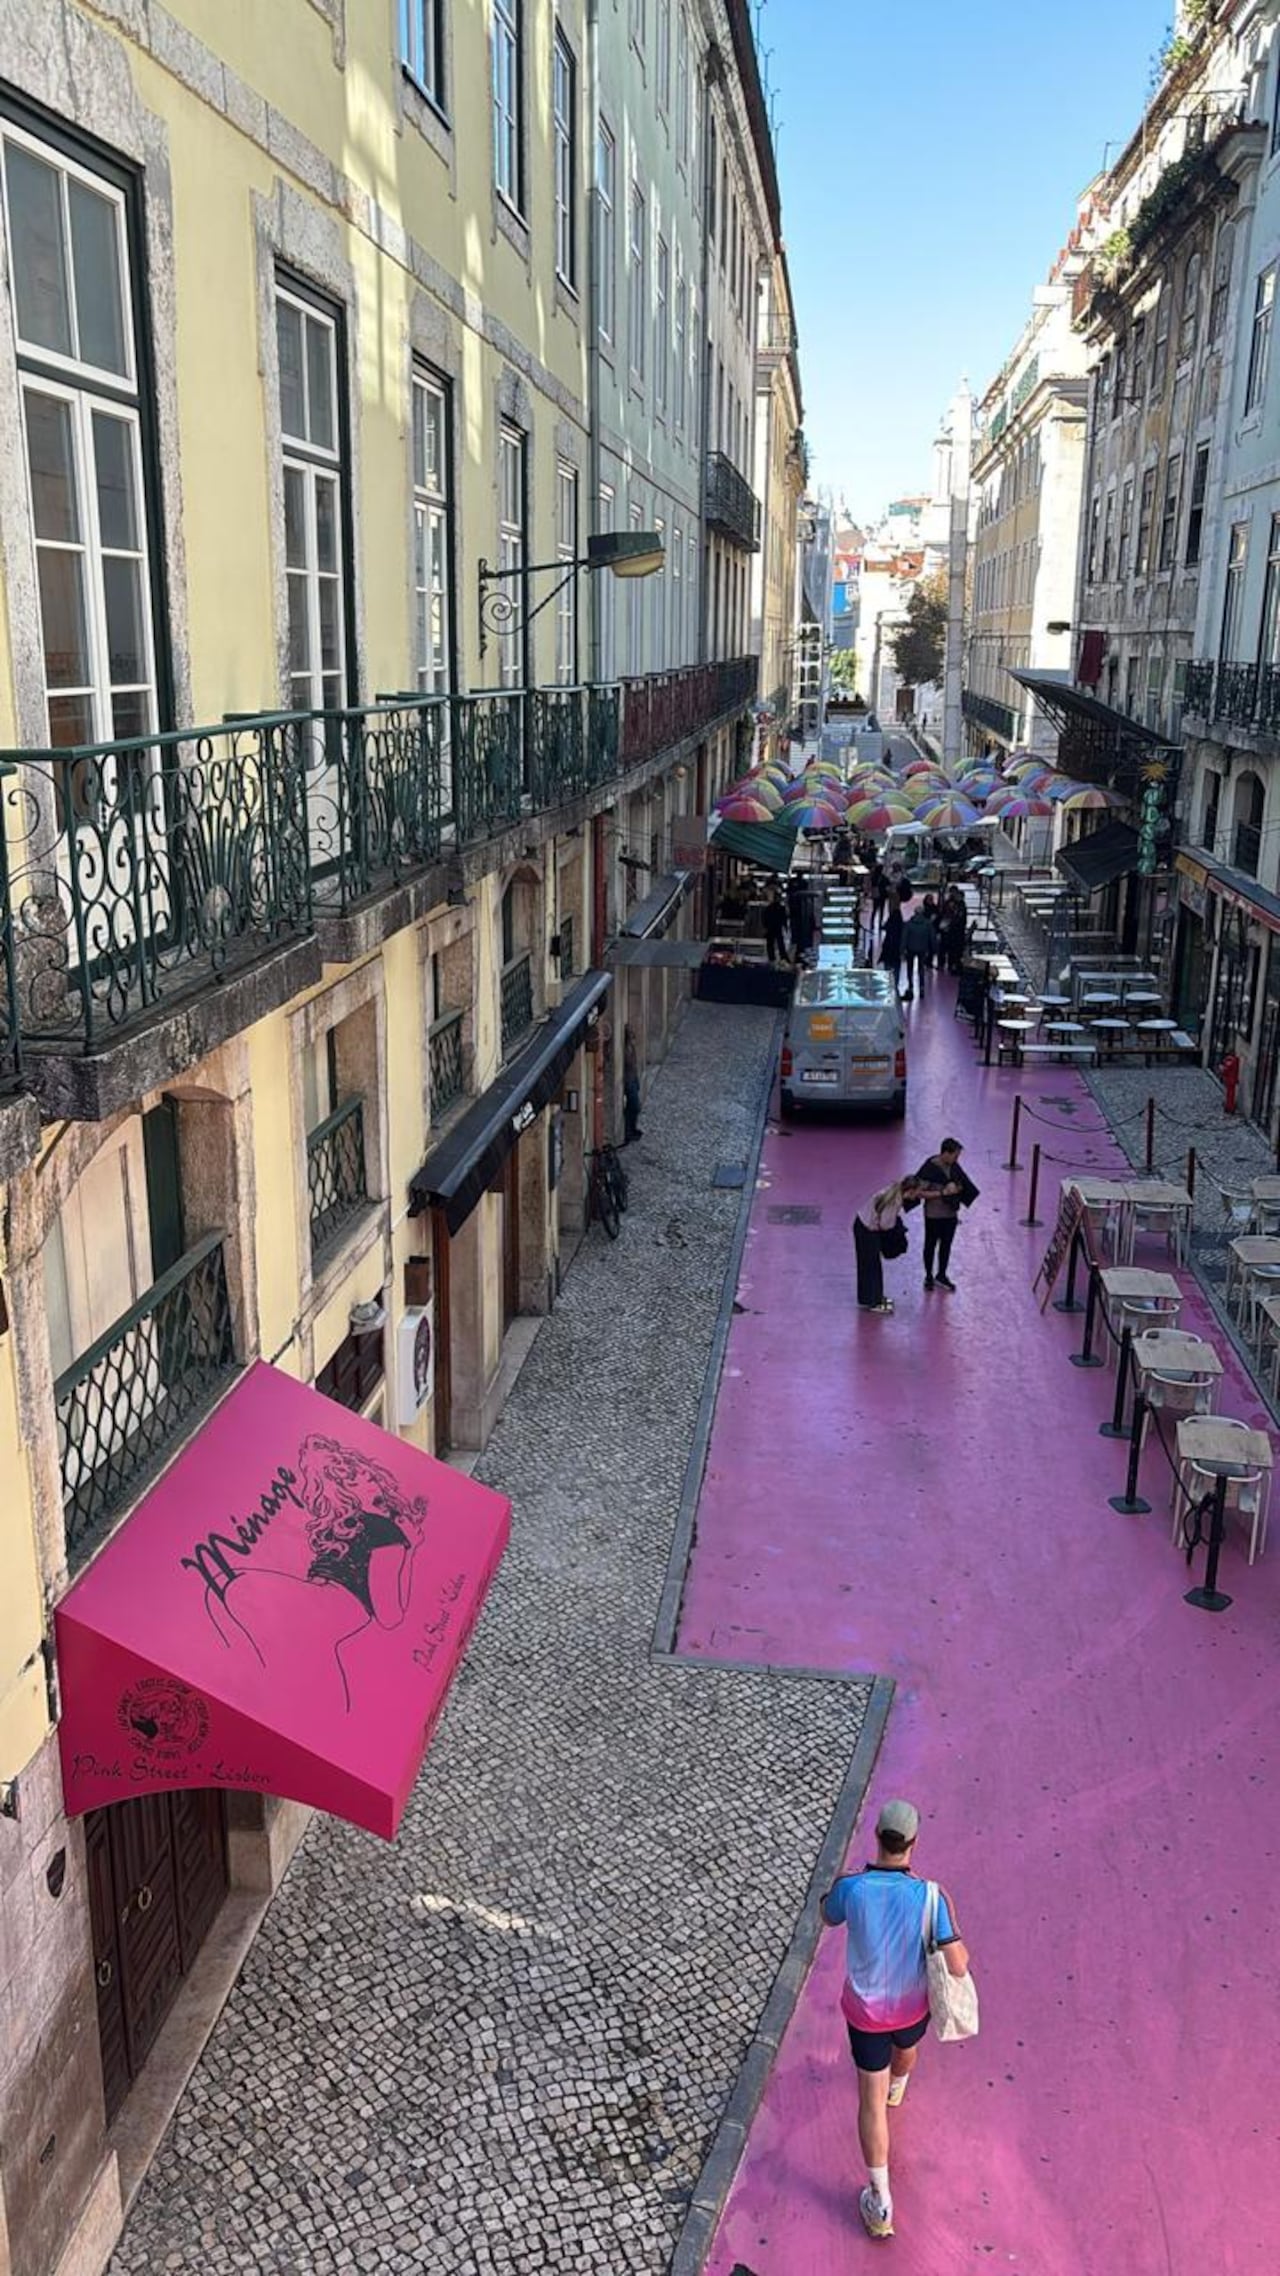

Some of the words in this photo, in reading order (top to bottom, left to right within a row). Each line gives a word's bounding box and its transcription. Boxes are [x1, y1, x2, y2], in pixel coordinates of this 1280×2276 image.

[181, 1466, 304, 1603] Ménage
[71, 1754, 122, 1779] Pink
[129, 1756, 189, 1782] Street
[209, 1760, 271, 1785] Lisbon
